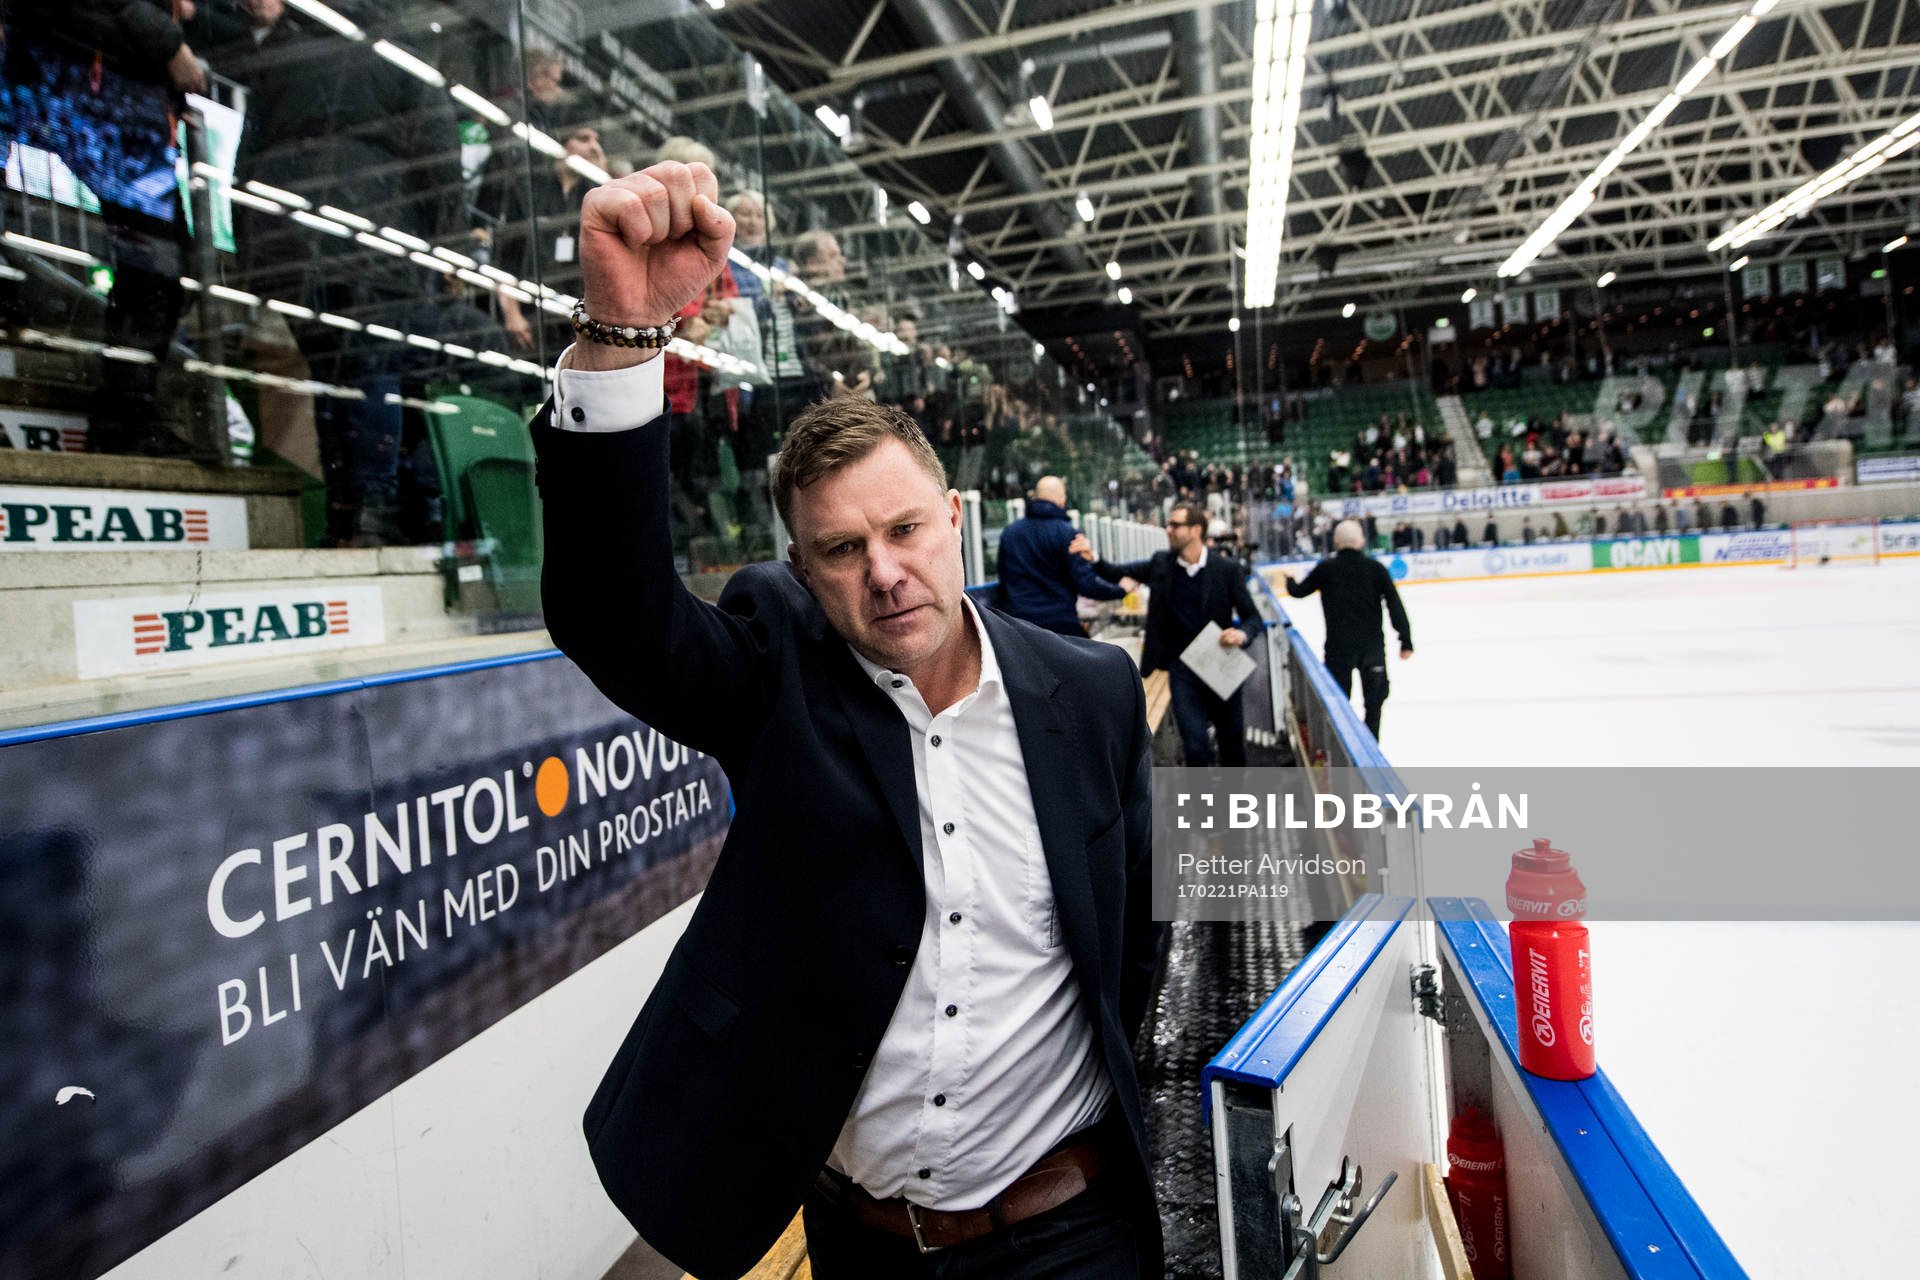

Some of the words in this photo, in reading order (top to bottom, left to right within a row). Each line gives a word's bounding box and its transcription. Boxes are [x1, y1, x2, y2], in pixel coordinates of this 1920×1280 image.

[2, 503, 185, 542] PEAB
[162, 601, 328, 653] PEAB
[576, 727, 704, 805] NOVU
[217, 954, 302, 1046] BLI
[320, 899, 429, 991] VÄN
[444, 864, 520, 938] MED
[535, 829, 591, 892] DIN
[599, 778, 712, 861] PROSTATA
[1529, 948, 1551, 1019] ENERVIT
[1458, 1160, 1496, 1171] ENERVIT
